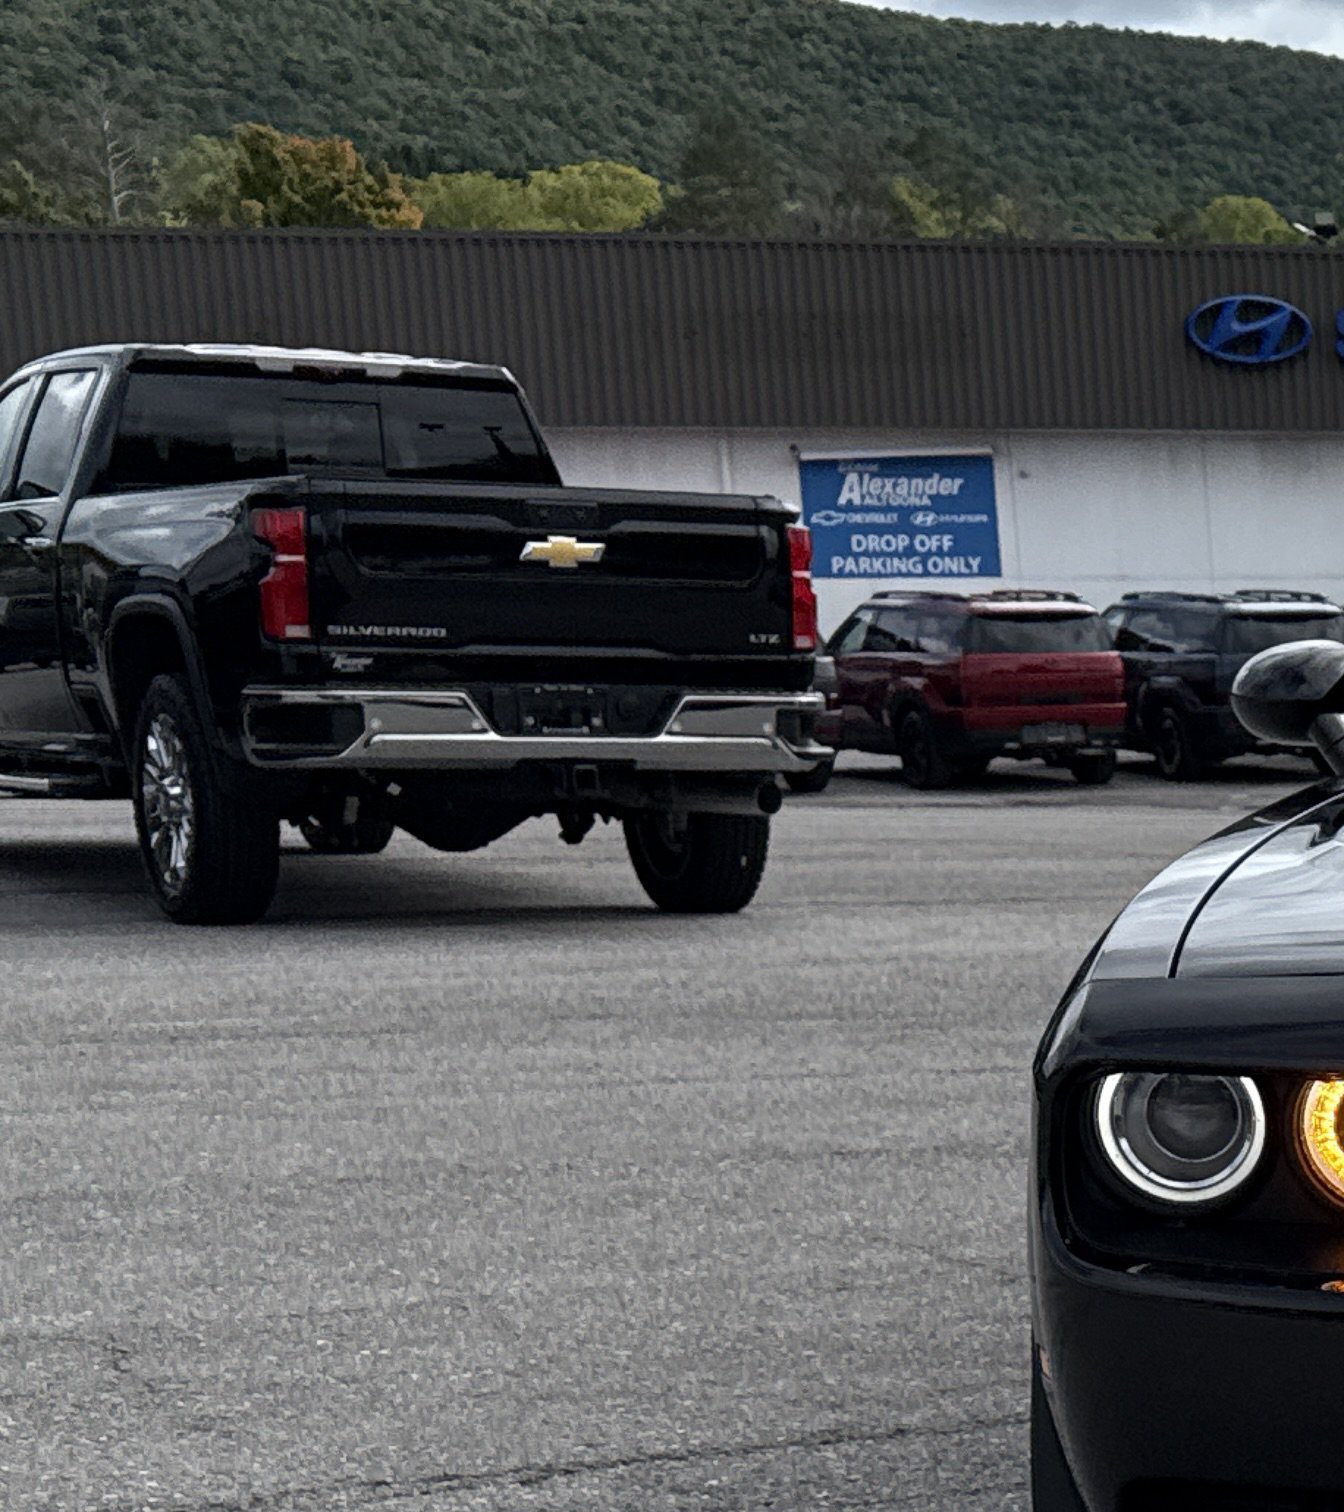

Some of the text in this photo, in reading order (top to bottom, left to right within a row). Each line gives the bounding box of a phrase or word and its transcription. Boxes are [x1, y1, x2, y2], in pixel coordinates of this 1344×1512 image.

[837, 473, 964, 507] Alexander
[851, 534, 954, 553] DROP OFF
[831, 556, 982, 575] PARKING ONLY
[326, 624, 447, 637] SILVERADO
